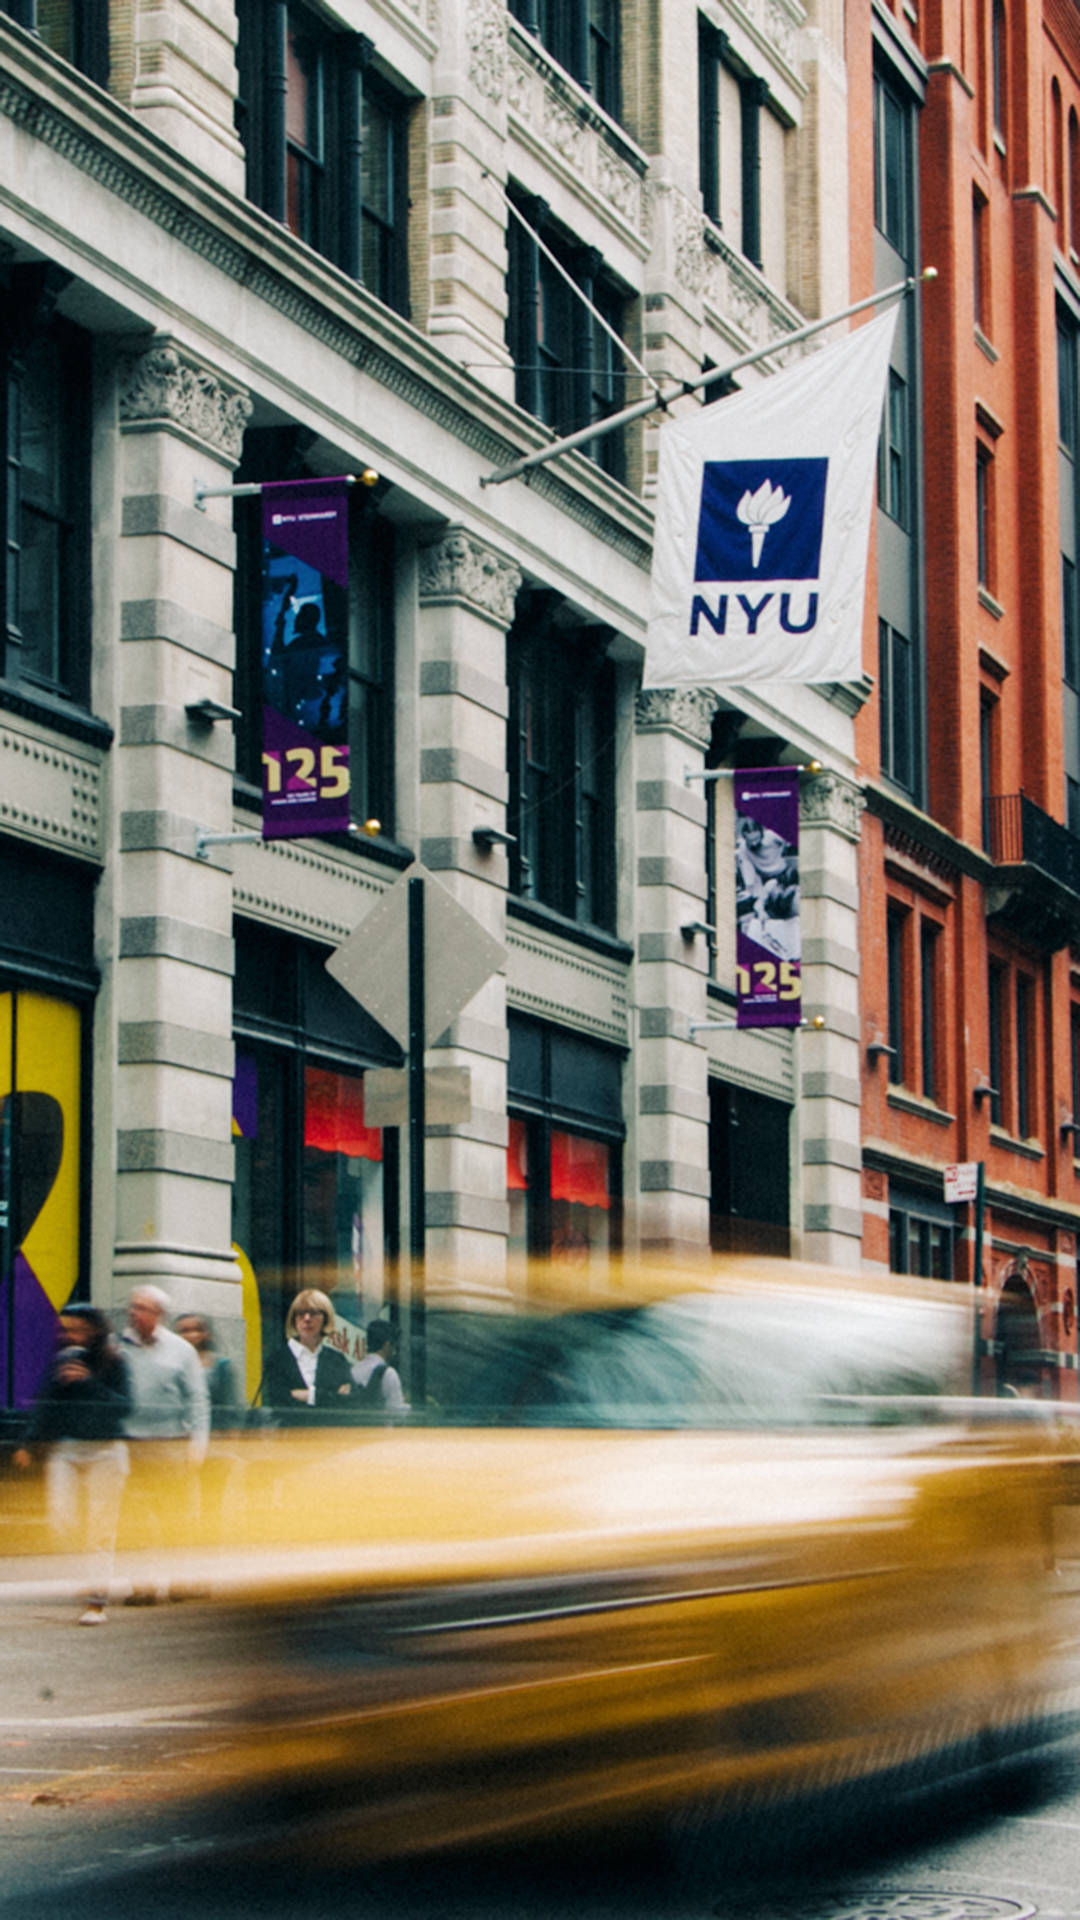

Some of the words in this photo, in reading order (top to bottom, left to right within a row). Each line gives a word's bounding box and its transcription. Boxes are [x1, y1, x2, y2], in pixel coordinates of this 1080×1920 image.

[690, 592, 819, 636] NYU
[262, 745, 350, 799] 125
[736, 961, 802, 1000] 125
